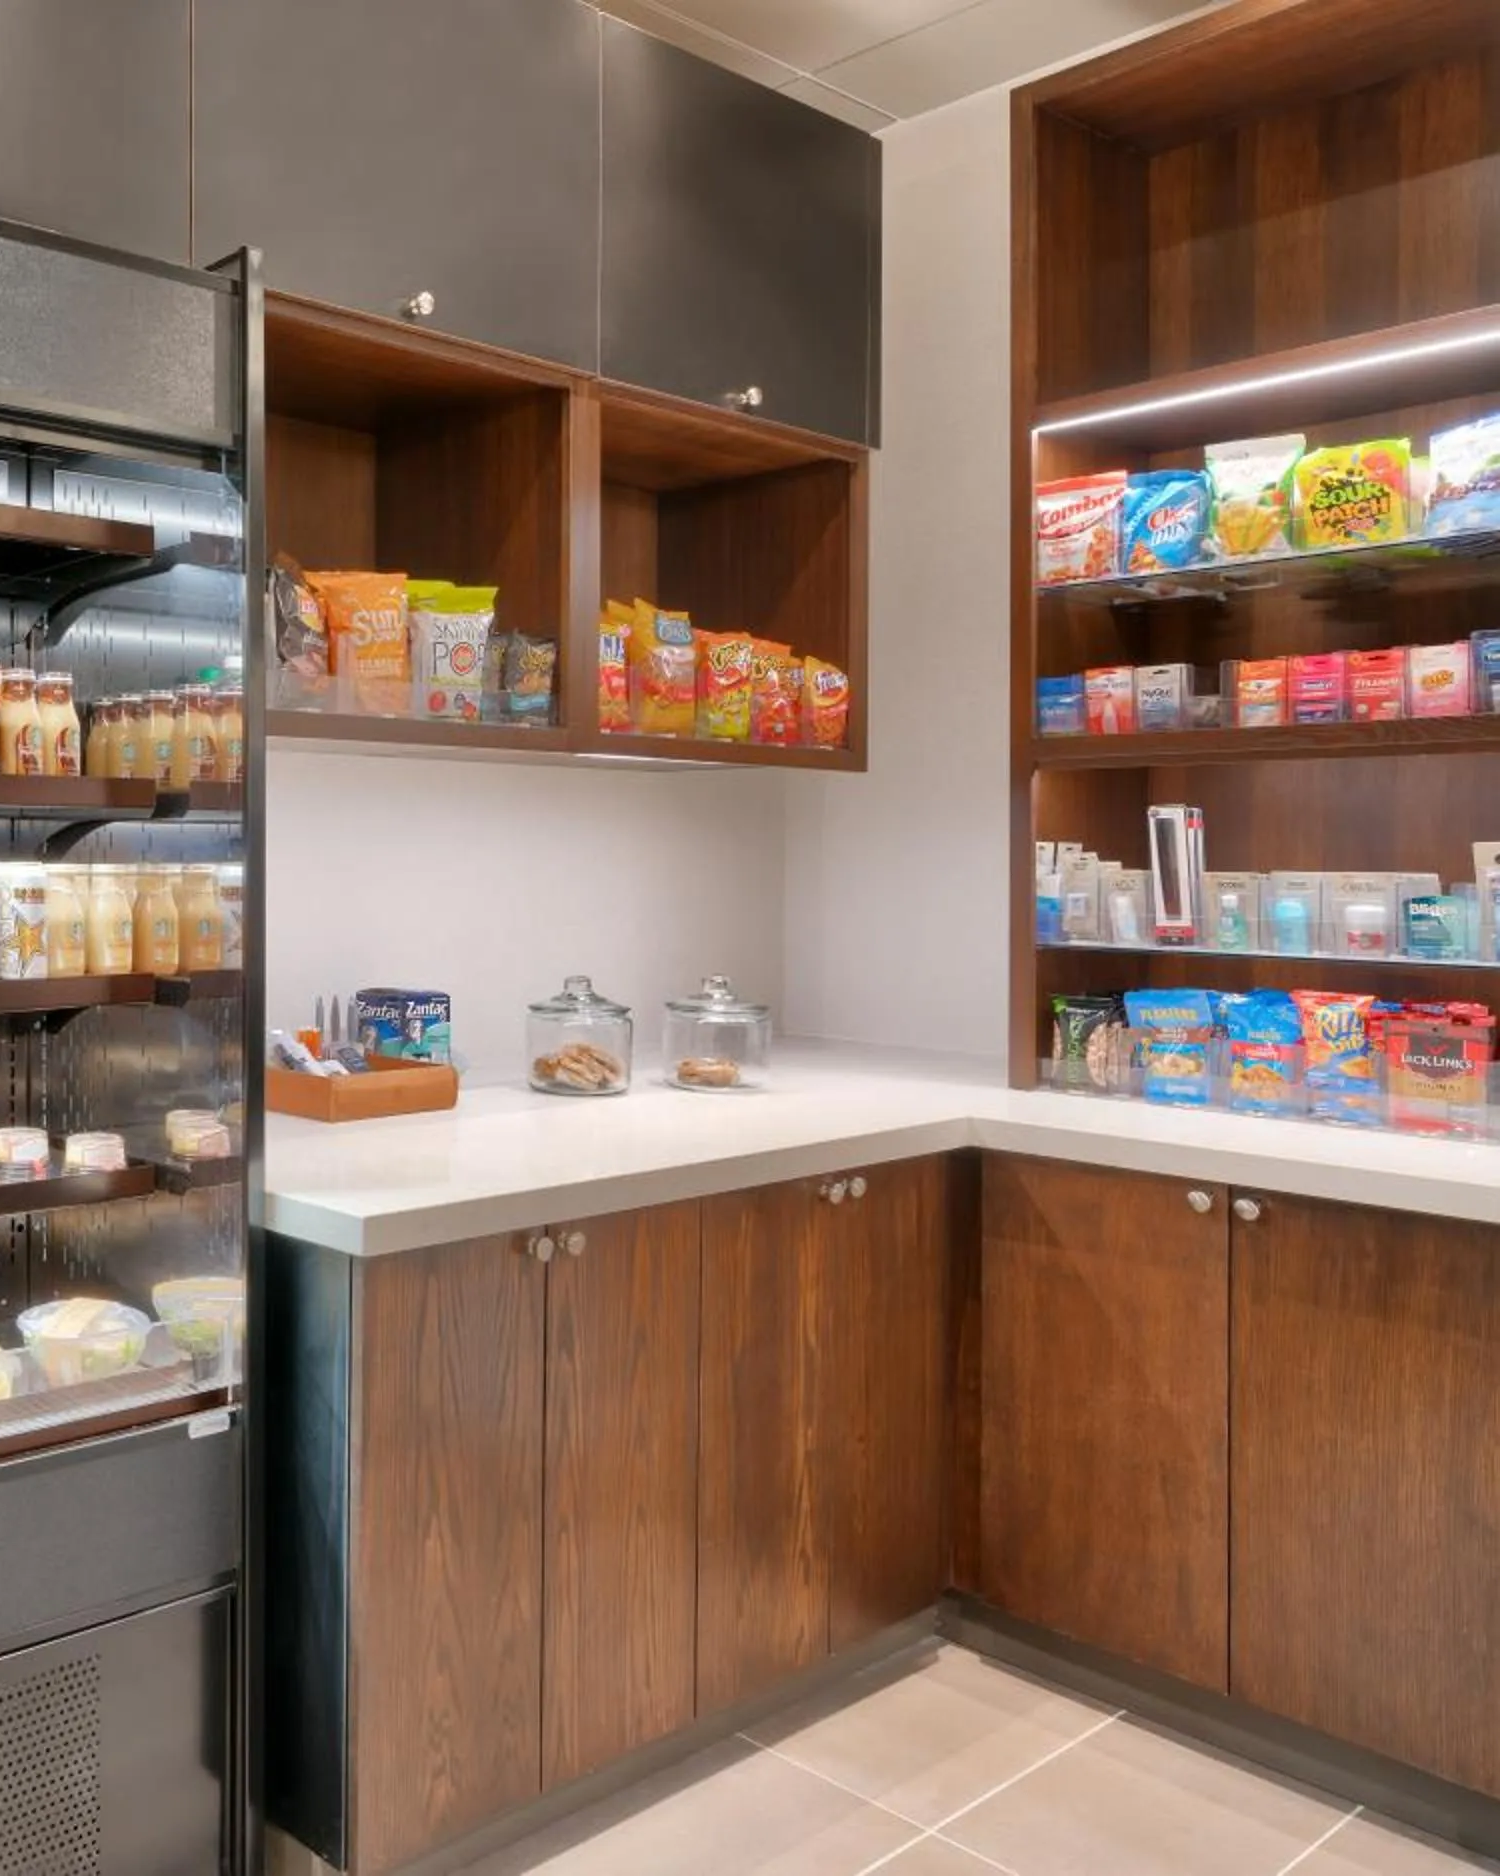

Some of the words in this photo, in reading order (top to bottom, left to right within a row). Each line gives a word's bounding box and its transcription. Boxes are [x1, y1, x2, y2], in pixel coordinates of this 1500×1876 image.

[1311, 497, 1391, 528] PATCH
[356, 1001, 401, 1019] Zantac
[405, 1001, 447, 1017] Zantac
